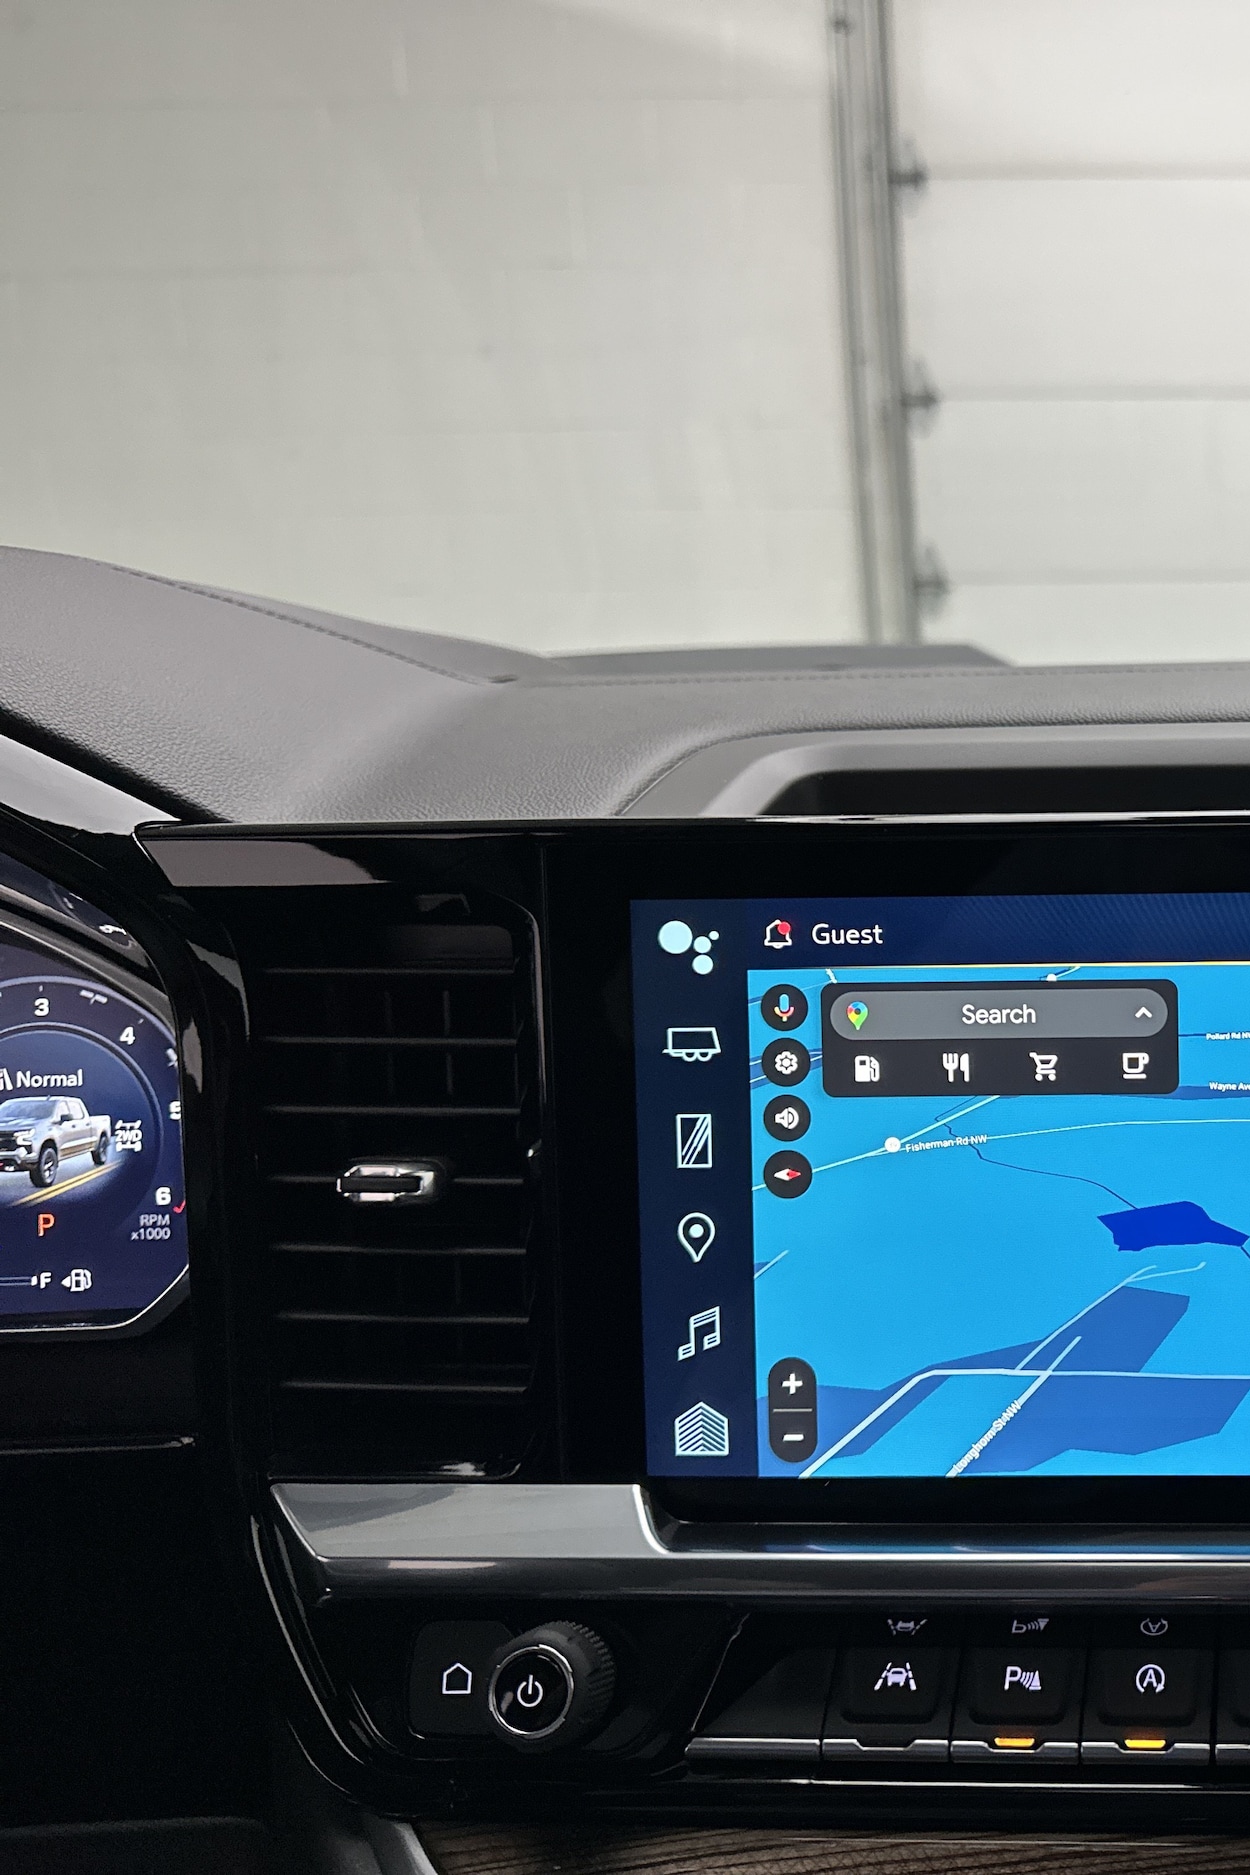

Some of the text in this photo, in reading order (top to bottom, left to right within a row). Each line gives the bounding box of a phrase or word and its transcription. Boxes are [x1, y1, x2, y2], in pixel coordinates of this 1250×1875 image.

[811, 923, 884, 945] Guest
[34, 998, 50, 1017] 3
[961, 1003, 1037, 1025] Search
[119, 1026, 136, 1045] 4
[1206, 1033, 1230, 1041] Pollard
[1231, 1032, 1241, 1040] Rd
[16, 1069, 83, 1088] Normal
[1209, 1082, 1236, 1092] Wayne
[115, 1130, 143, 1142] 2WD
[905, 1139, 954, 1153] Fisherman
[955, 1136, 969, 1146] Rd
[970, 1134, 988, 1145] NW
[155, 1186, 172, 1206] 6
[37, 1213, 55, 1237] P
[139, 1213, 170, 1226] RPM
[130, 1227, 171, 1241] x1000
[39, 1272, 52, 1289] F
[952, 1429, 997, 1474] Longhorn
[1001, 1400, 1022, 1422] NW
